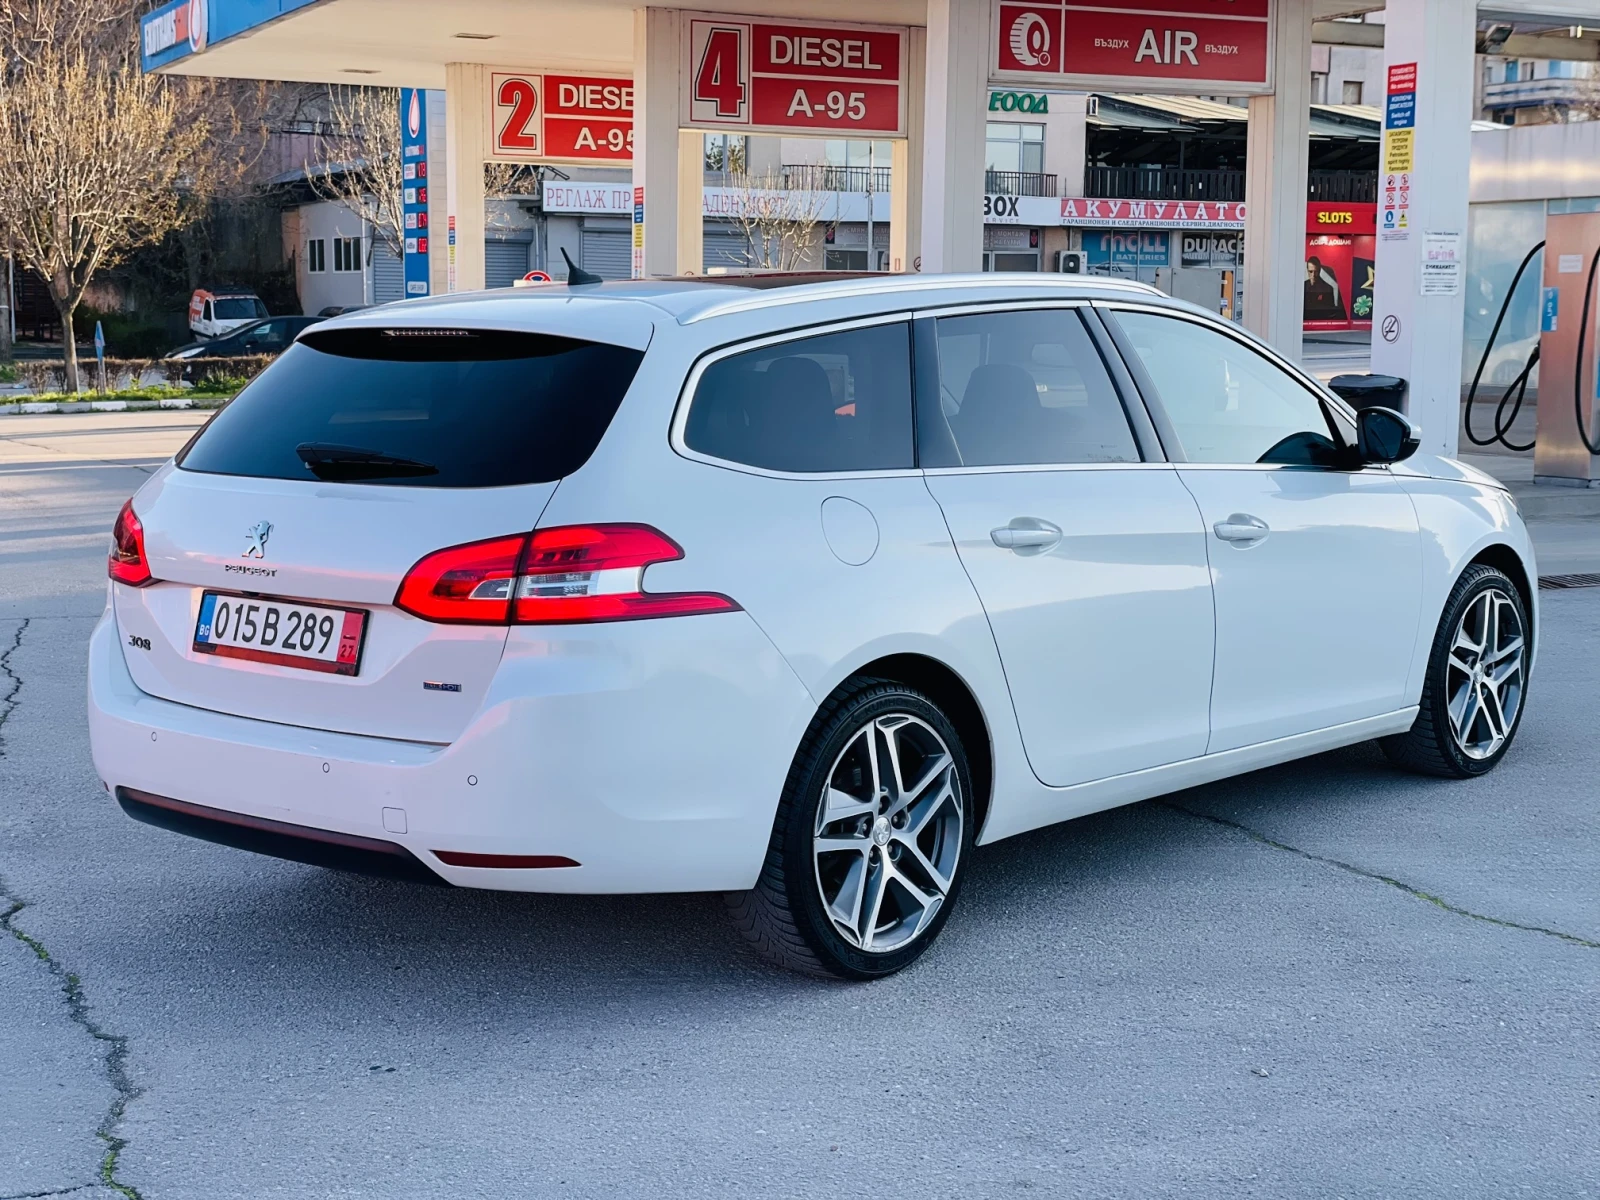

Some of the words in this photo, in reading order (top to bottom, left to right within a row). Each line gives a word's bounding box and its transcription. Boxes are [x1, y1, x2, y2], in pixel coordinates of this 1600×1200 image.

[770, 35, 882, 70] DIESEL
[1094, 38, 1129, 49] ВЪЗДУХ
[1134, 28, 1199, 66] AIR
[1204, 44, 1238, 55] ВЪЗДУХ
[695, 28, 746, 117] 4
[498, 78, 537, 150] 2
[786, 88, 866, 120] A-95
[546, 188, 606, 209] РЕГЛАЖ
[1317, 211, 1353, 224] SLOTS
[1116, 253, 1166, 261] BATTERIES
[225, 564, 278, 577] PEUGEOT
[199, 624, 210, 636] BG
[128, 634, 152, 651] 308
